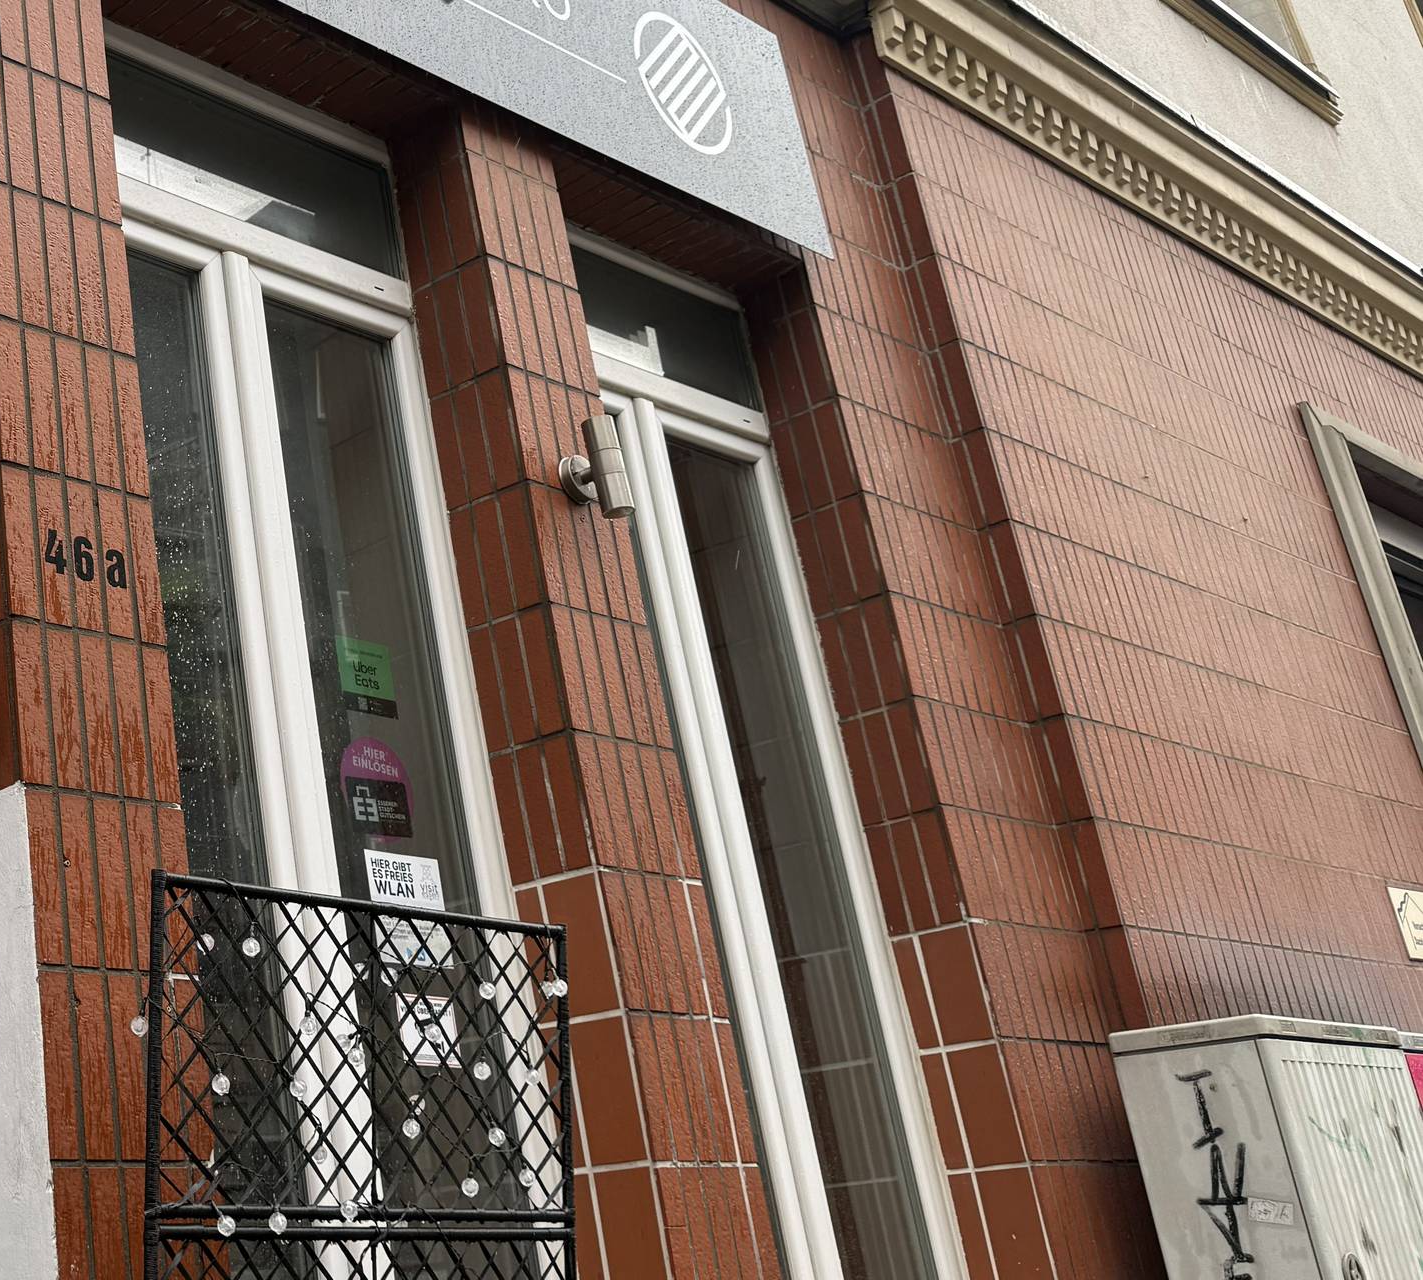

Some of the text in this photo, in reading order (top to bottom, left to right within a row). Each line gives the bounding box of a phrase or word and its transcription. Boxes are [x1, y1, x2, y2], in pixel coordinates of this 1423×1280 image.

[353, 660, 377, 676] Uber
[355, 673, 380, 690] Eats
[363, 746, 386, 761] HIER
[352, 755, 399, 777] EINLÖSEN
[370, 857, 411, 872] HIER GIBT
[372, 868, 414, 883] ES FREIES
[374, 879, 415, 899] WLAN
